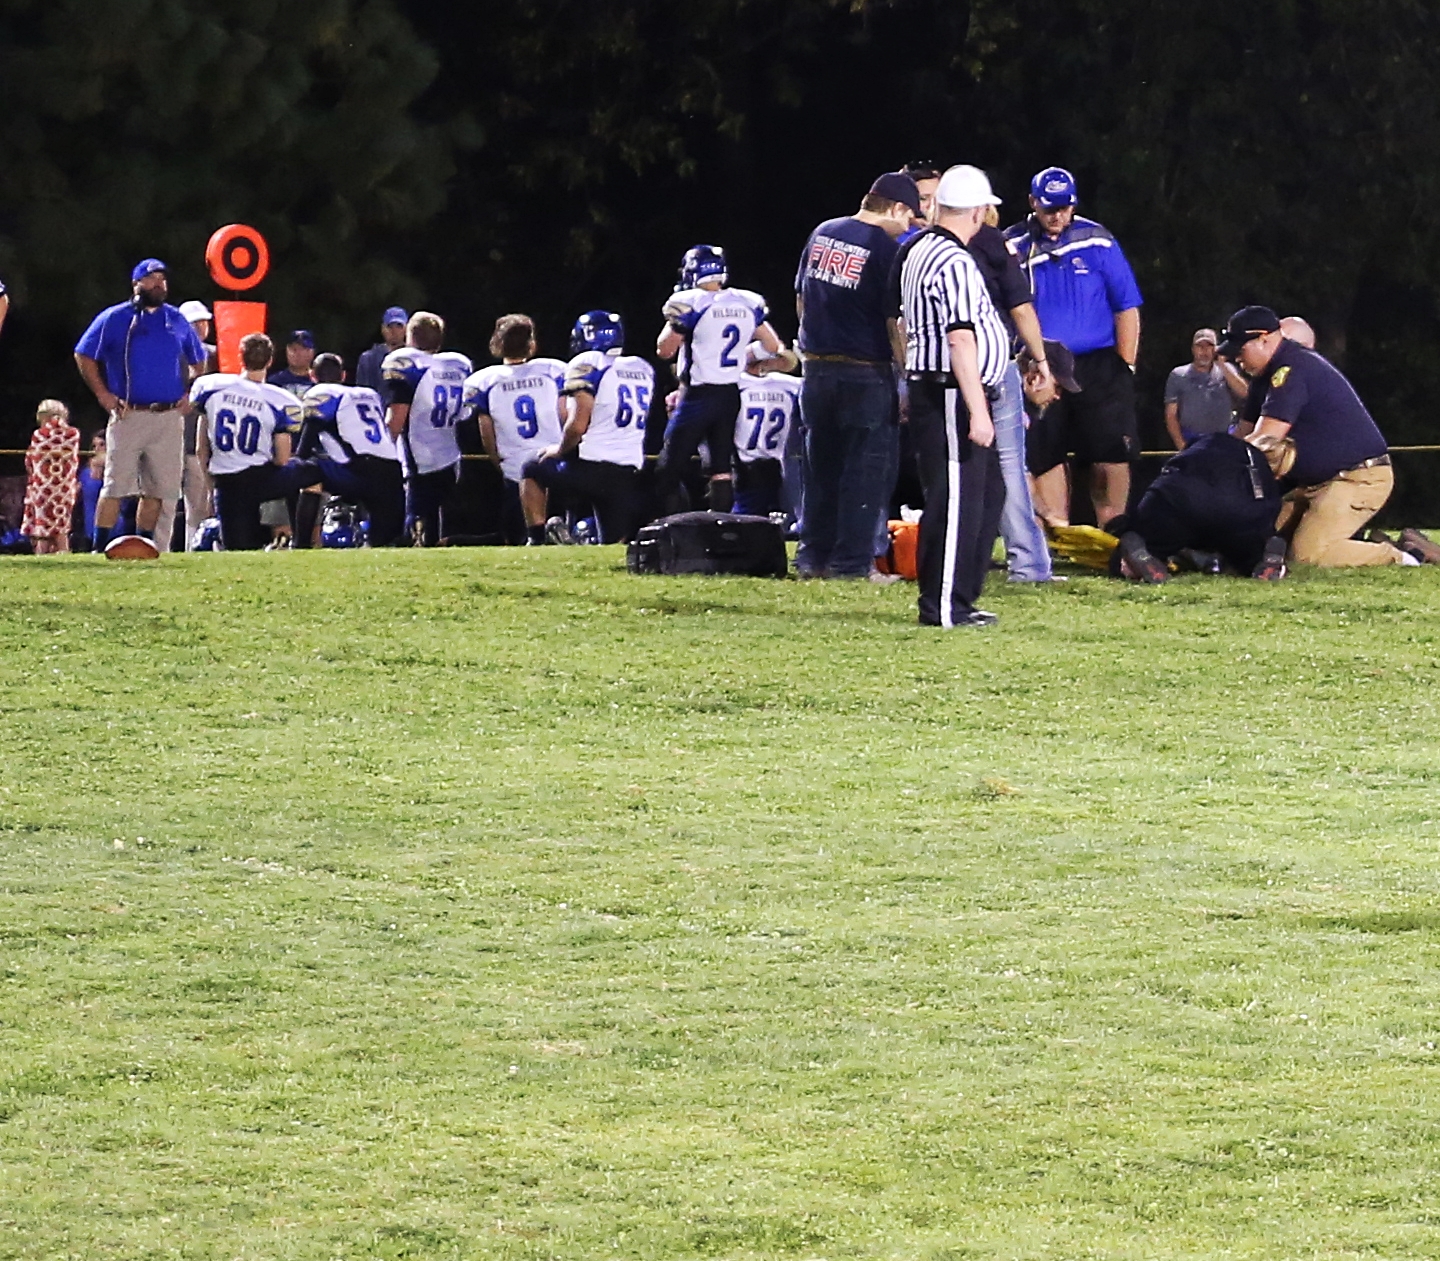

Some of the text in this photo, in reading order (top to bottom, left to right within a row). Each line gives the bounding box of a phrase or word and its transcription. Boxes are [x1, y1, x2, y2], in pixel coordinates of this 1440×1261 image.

[808, 243, 866, 281] FIRE
[719, 323, 741, 368] 2
[222, 393, 264, 411] WILDCATS
[430, 384, 463, 428] 87
[513, 394, 539, 439] 9
[615, 383, 649, 430] 65
[215, 408, 261, 456] 60
[746, 407, 786, 450] 72
